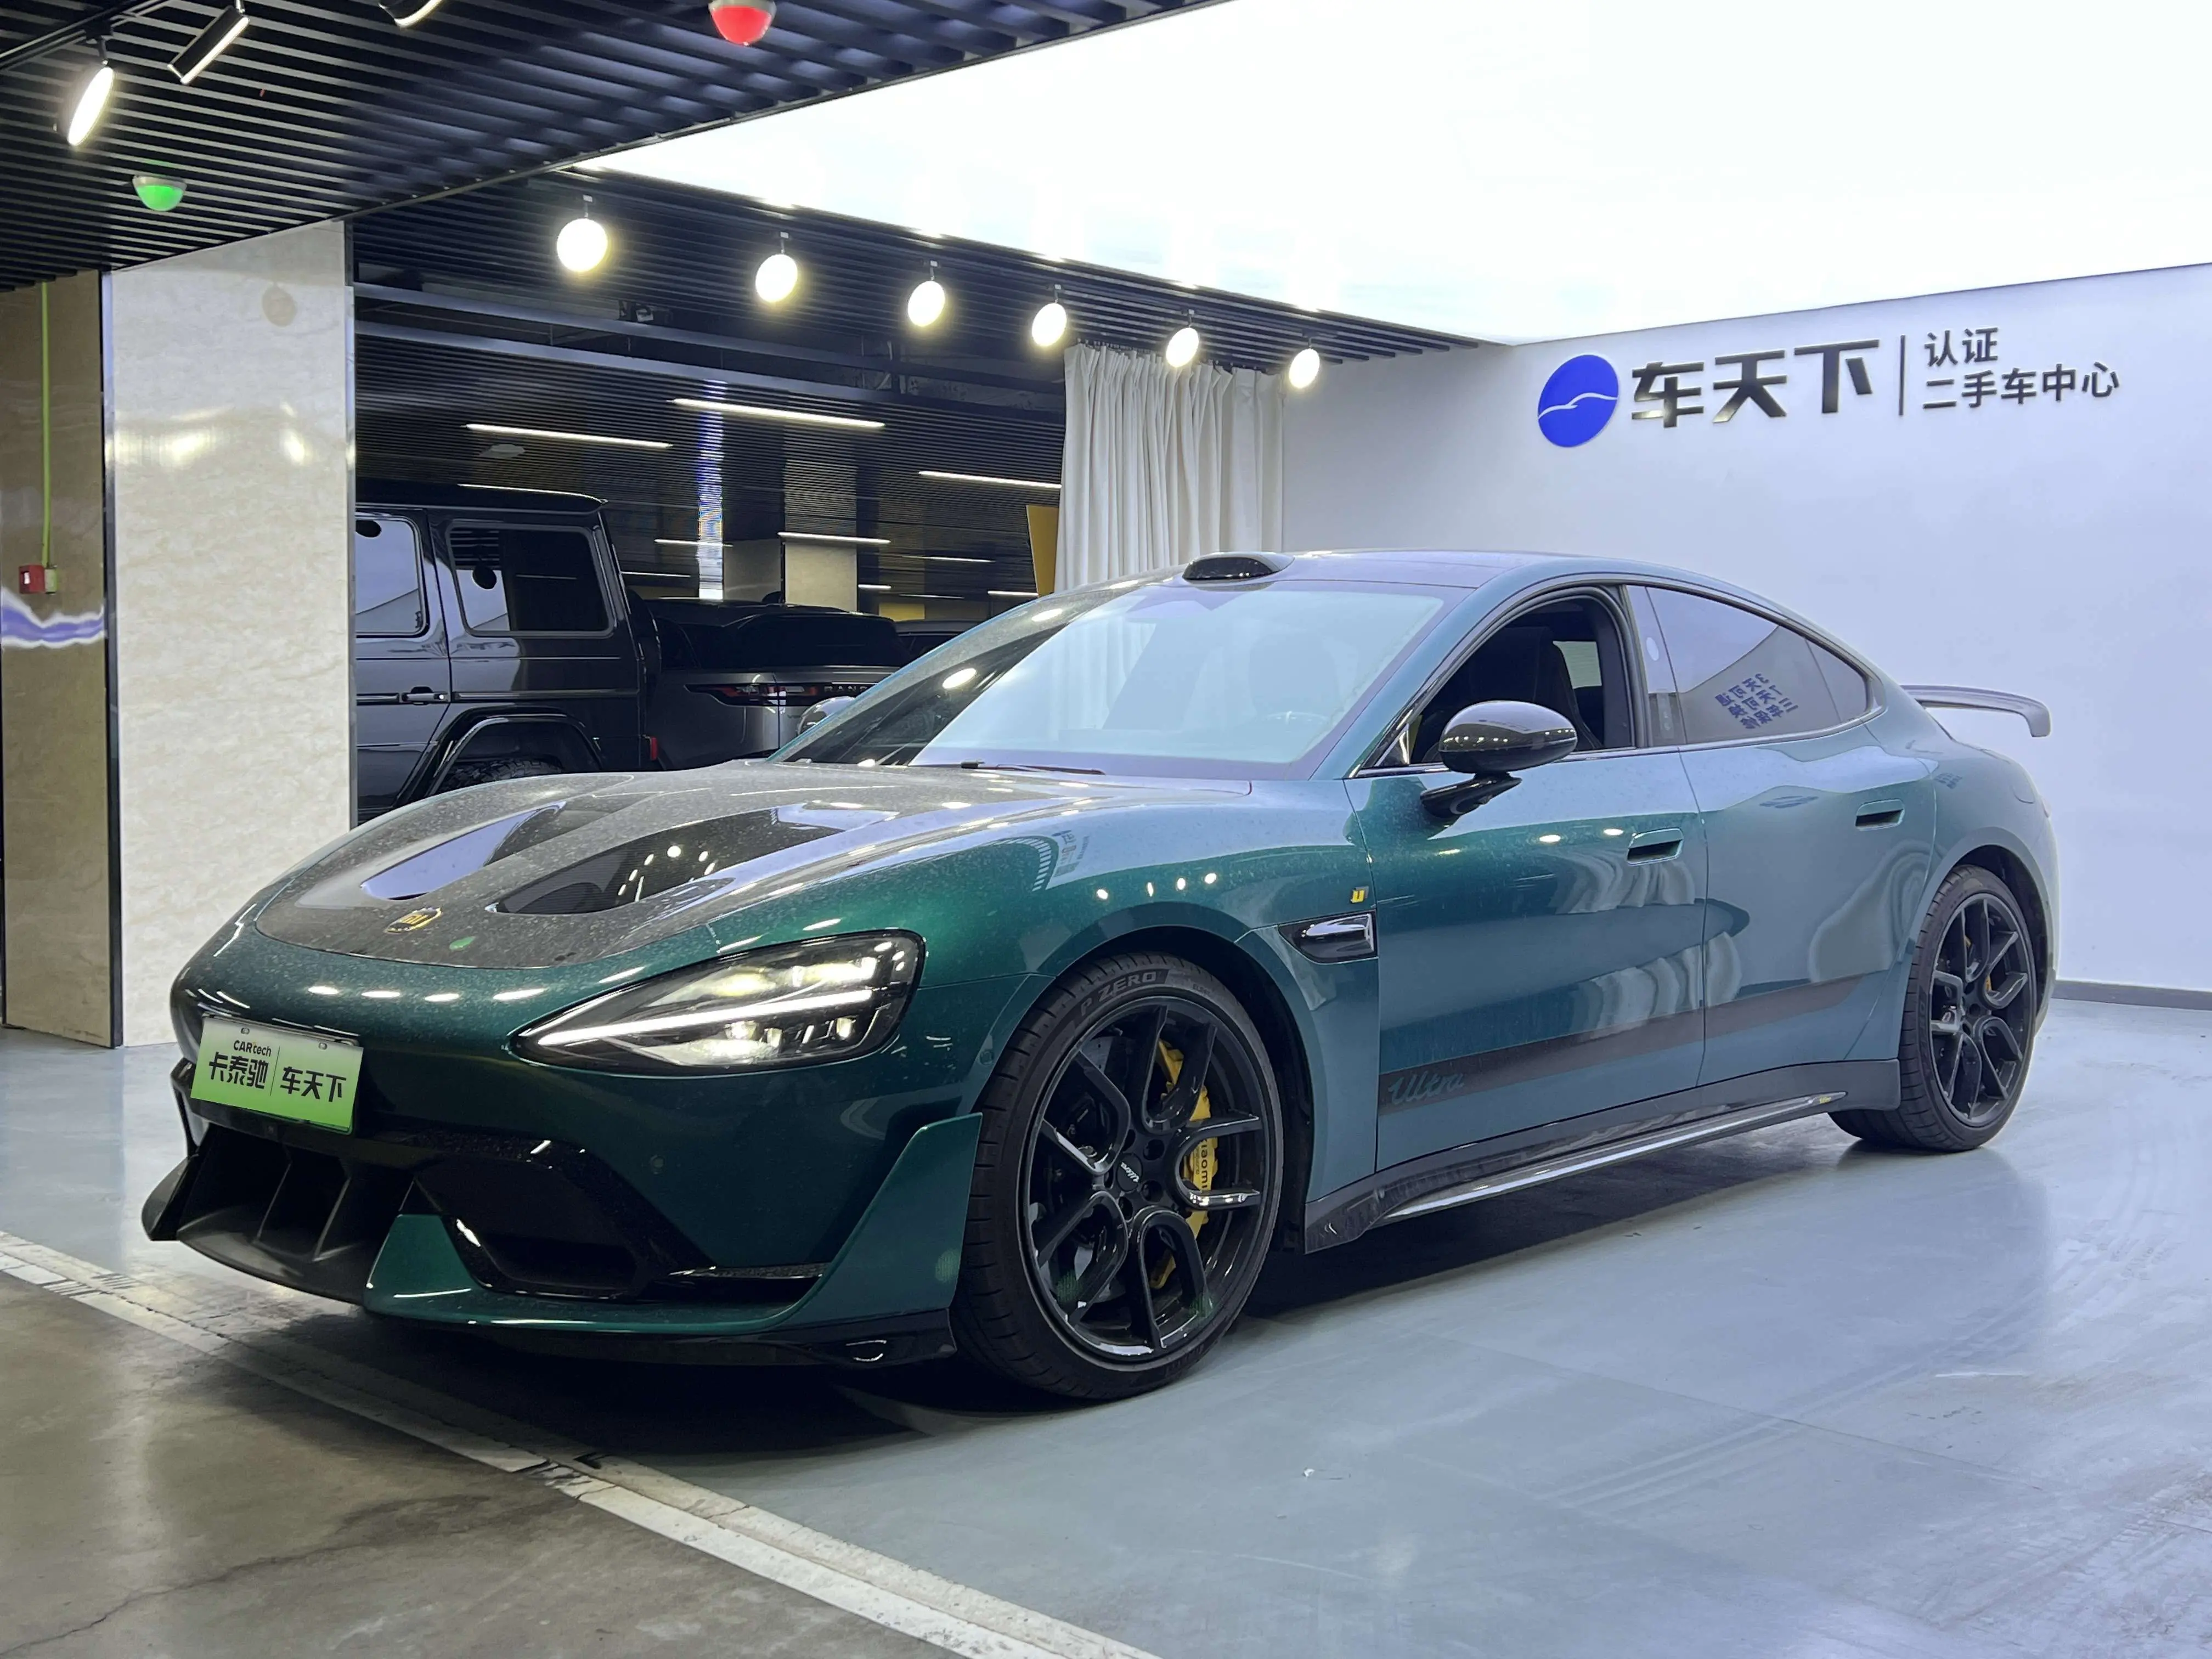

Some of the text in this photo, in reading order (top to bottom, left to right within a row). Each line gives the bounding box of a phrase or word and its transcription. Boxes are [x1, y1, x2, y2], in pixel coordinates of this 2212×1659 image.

[1923, 328, 1998, 365] 认证
[1631, 339, 1880, 428] 车天下
[1922, 362, 2119, 410] 二手车中心
[1080, 971, 1156, 1015] P ZERO
[233, 1040, 272, 1057] CARtech
[208, 1052, 347, 1102] 卡泰驰 车天下
